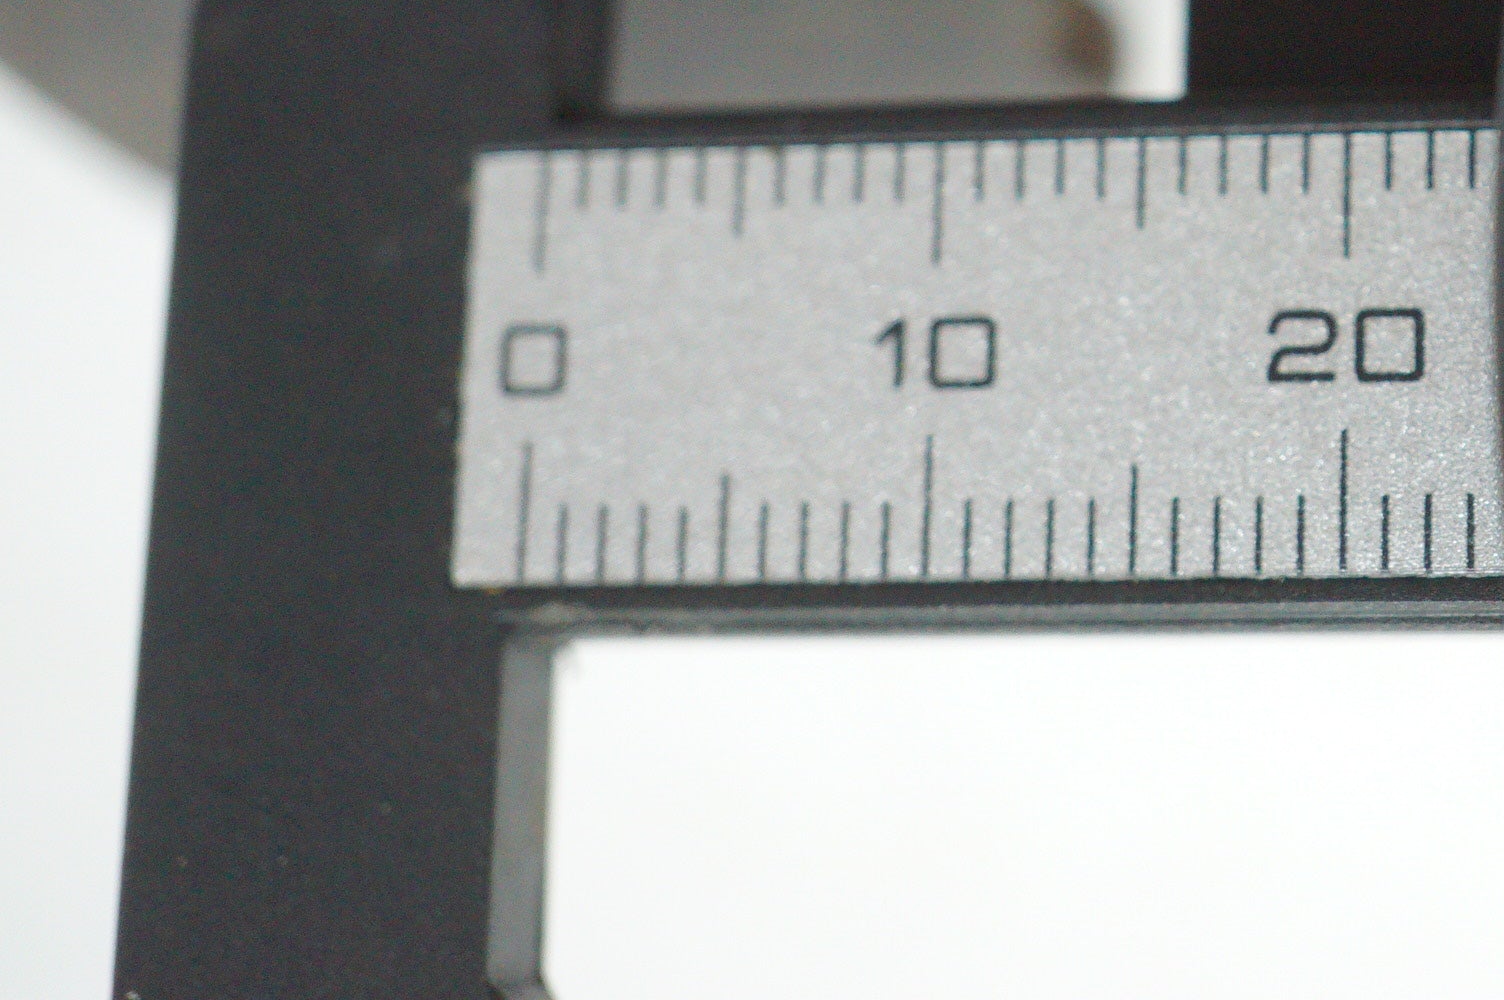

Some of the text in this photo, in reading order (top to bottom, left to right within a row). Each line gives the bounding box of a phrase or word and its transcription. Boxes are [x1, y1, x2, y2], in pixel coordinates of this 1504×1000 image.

[499, 306, 1426, 397] 0 10 20
